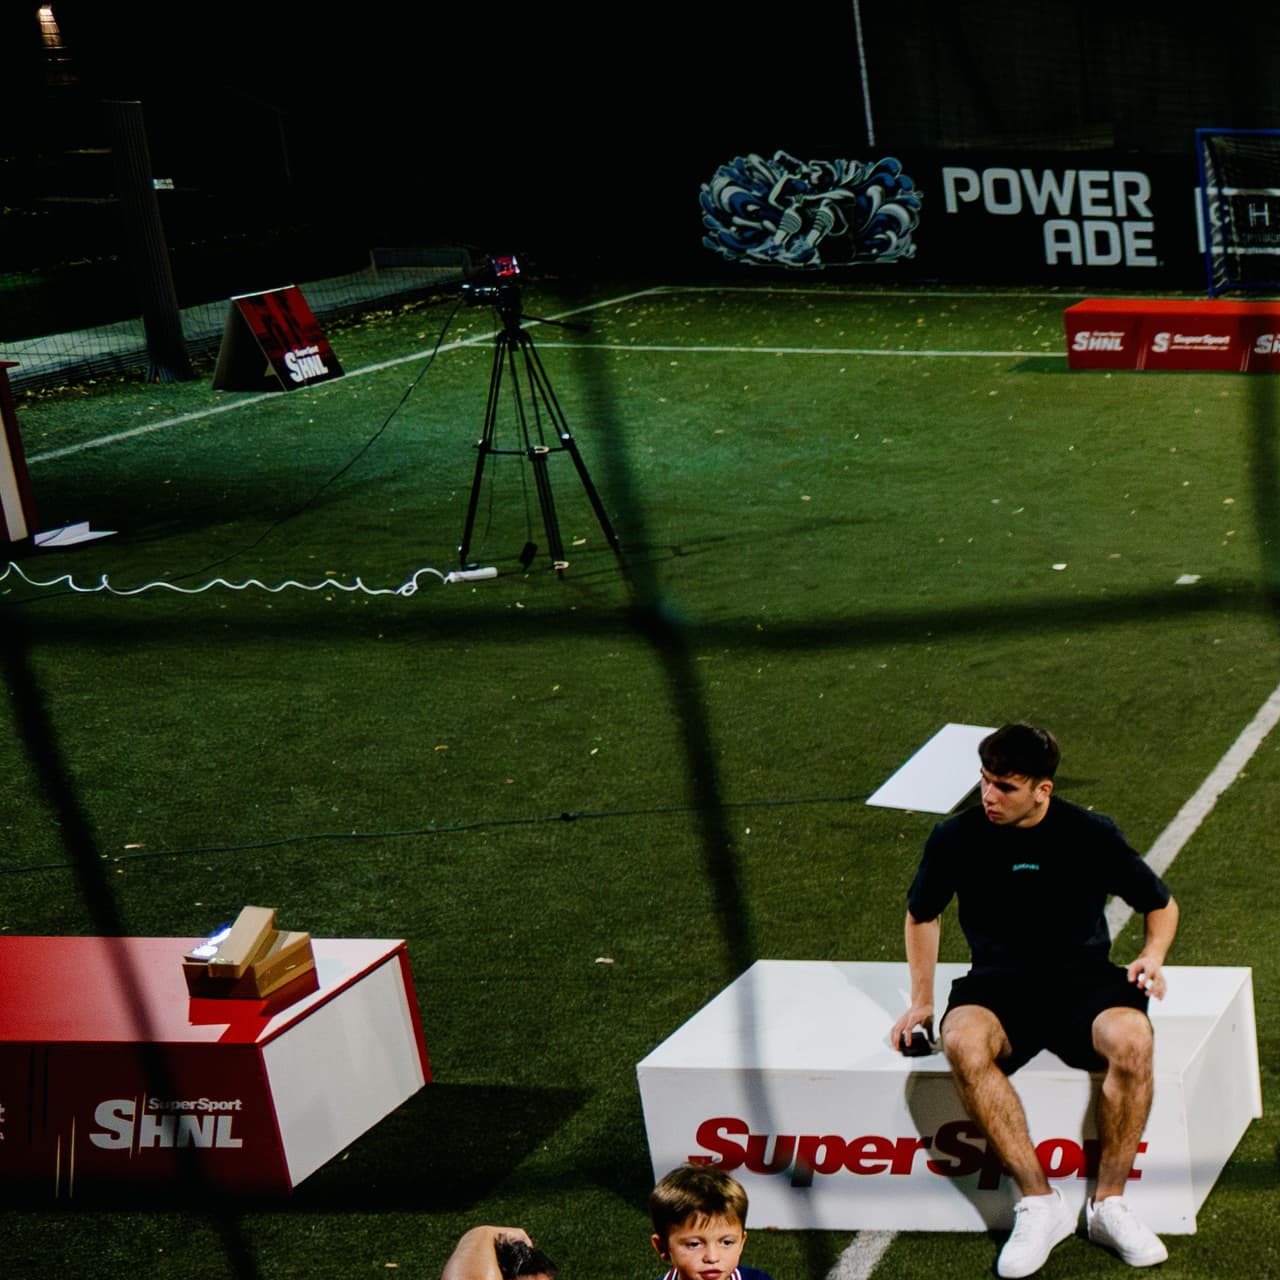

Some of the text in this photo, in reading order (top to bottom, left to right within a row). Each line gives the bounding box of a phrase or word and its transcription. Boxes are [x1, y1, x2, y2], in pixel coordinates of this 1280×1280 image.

[942, 167, 1153, 217] POWER
[1043, 219, 1158, 267] ADE
[148, 1098, 242, 1112] SuperSport
